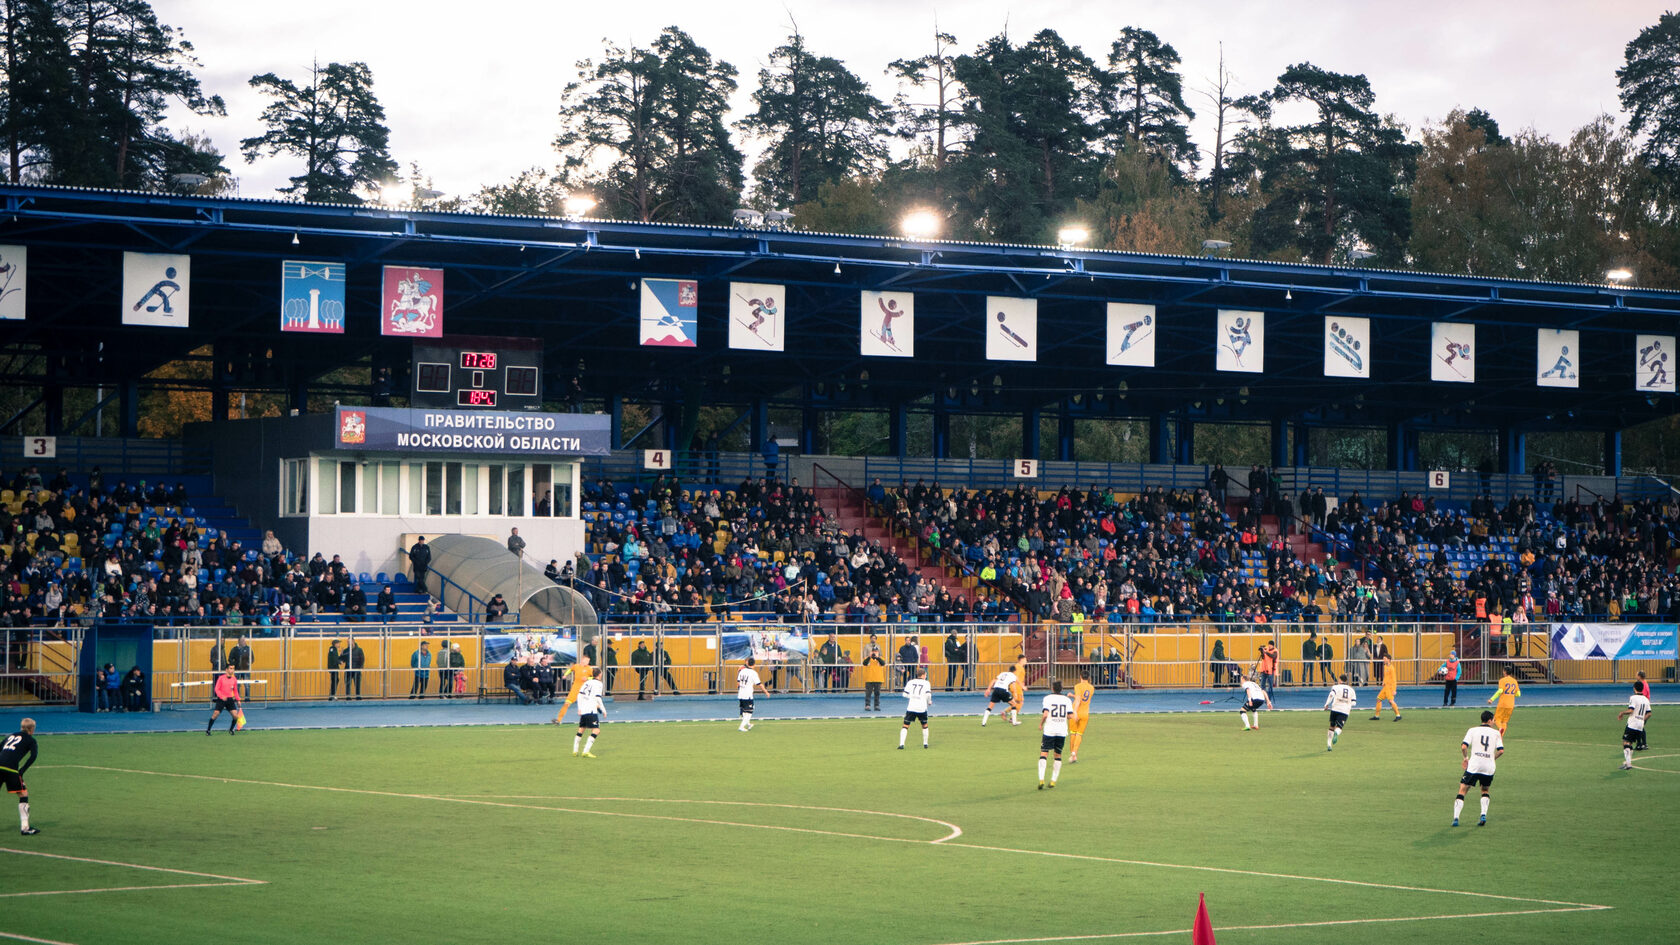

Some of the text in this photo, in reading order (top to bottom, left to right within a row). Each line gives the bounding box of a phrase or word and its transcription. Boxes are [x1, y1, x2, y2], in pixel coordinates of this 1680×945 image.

[425, 414, 555, 431] ПРАВИТЕЛЬСТВО
[34, 438, 46, 455] 3
[398, 433, 581, 451] МОСКОВСКОЙ ОБЛАСТИ
[652, 451, 664, 467] 4
[1021, 461, 1031, 475] 5
[1435, 473, 1444, 486] 6
[739, 674, 749, 685] 44
[583, 684, 593, 696] 24
[912, 683, 924, 696] 77
[1342, 688, 1349, 699] 8
[1504, 682, 1517, 695] 22
[1082, 690, 1090, 702] 9
[1051, 704, 1067, 718] 20
[1638, 704, 1645, 716] 11
[3, 735, 22, 750] 22
[1480, 735, 1489, 751] 4
